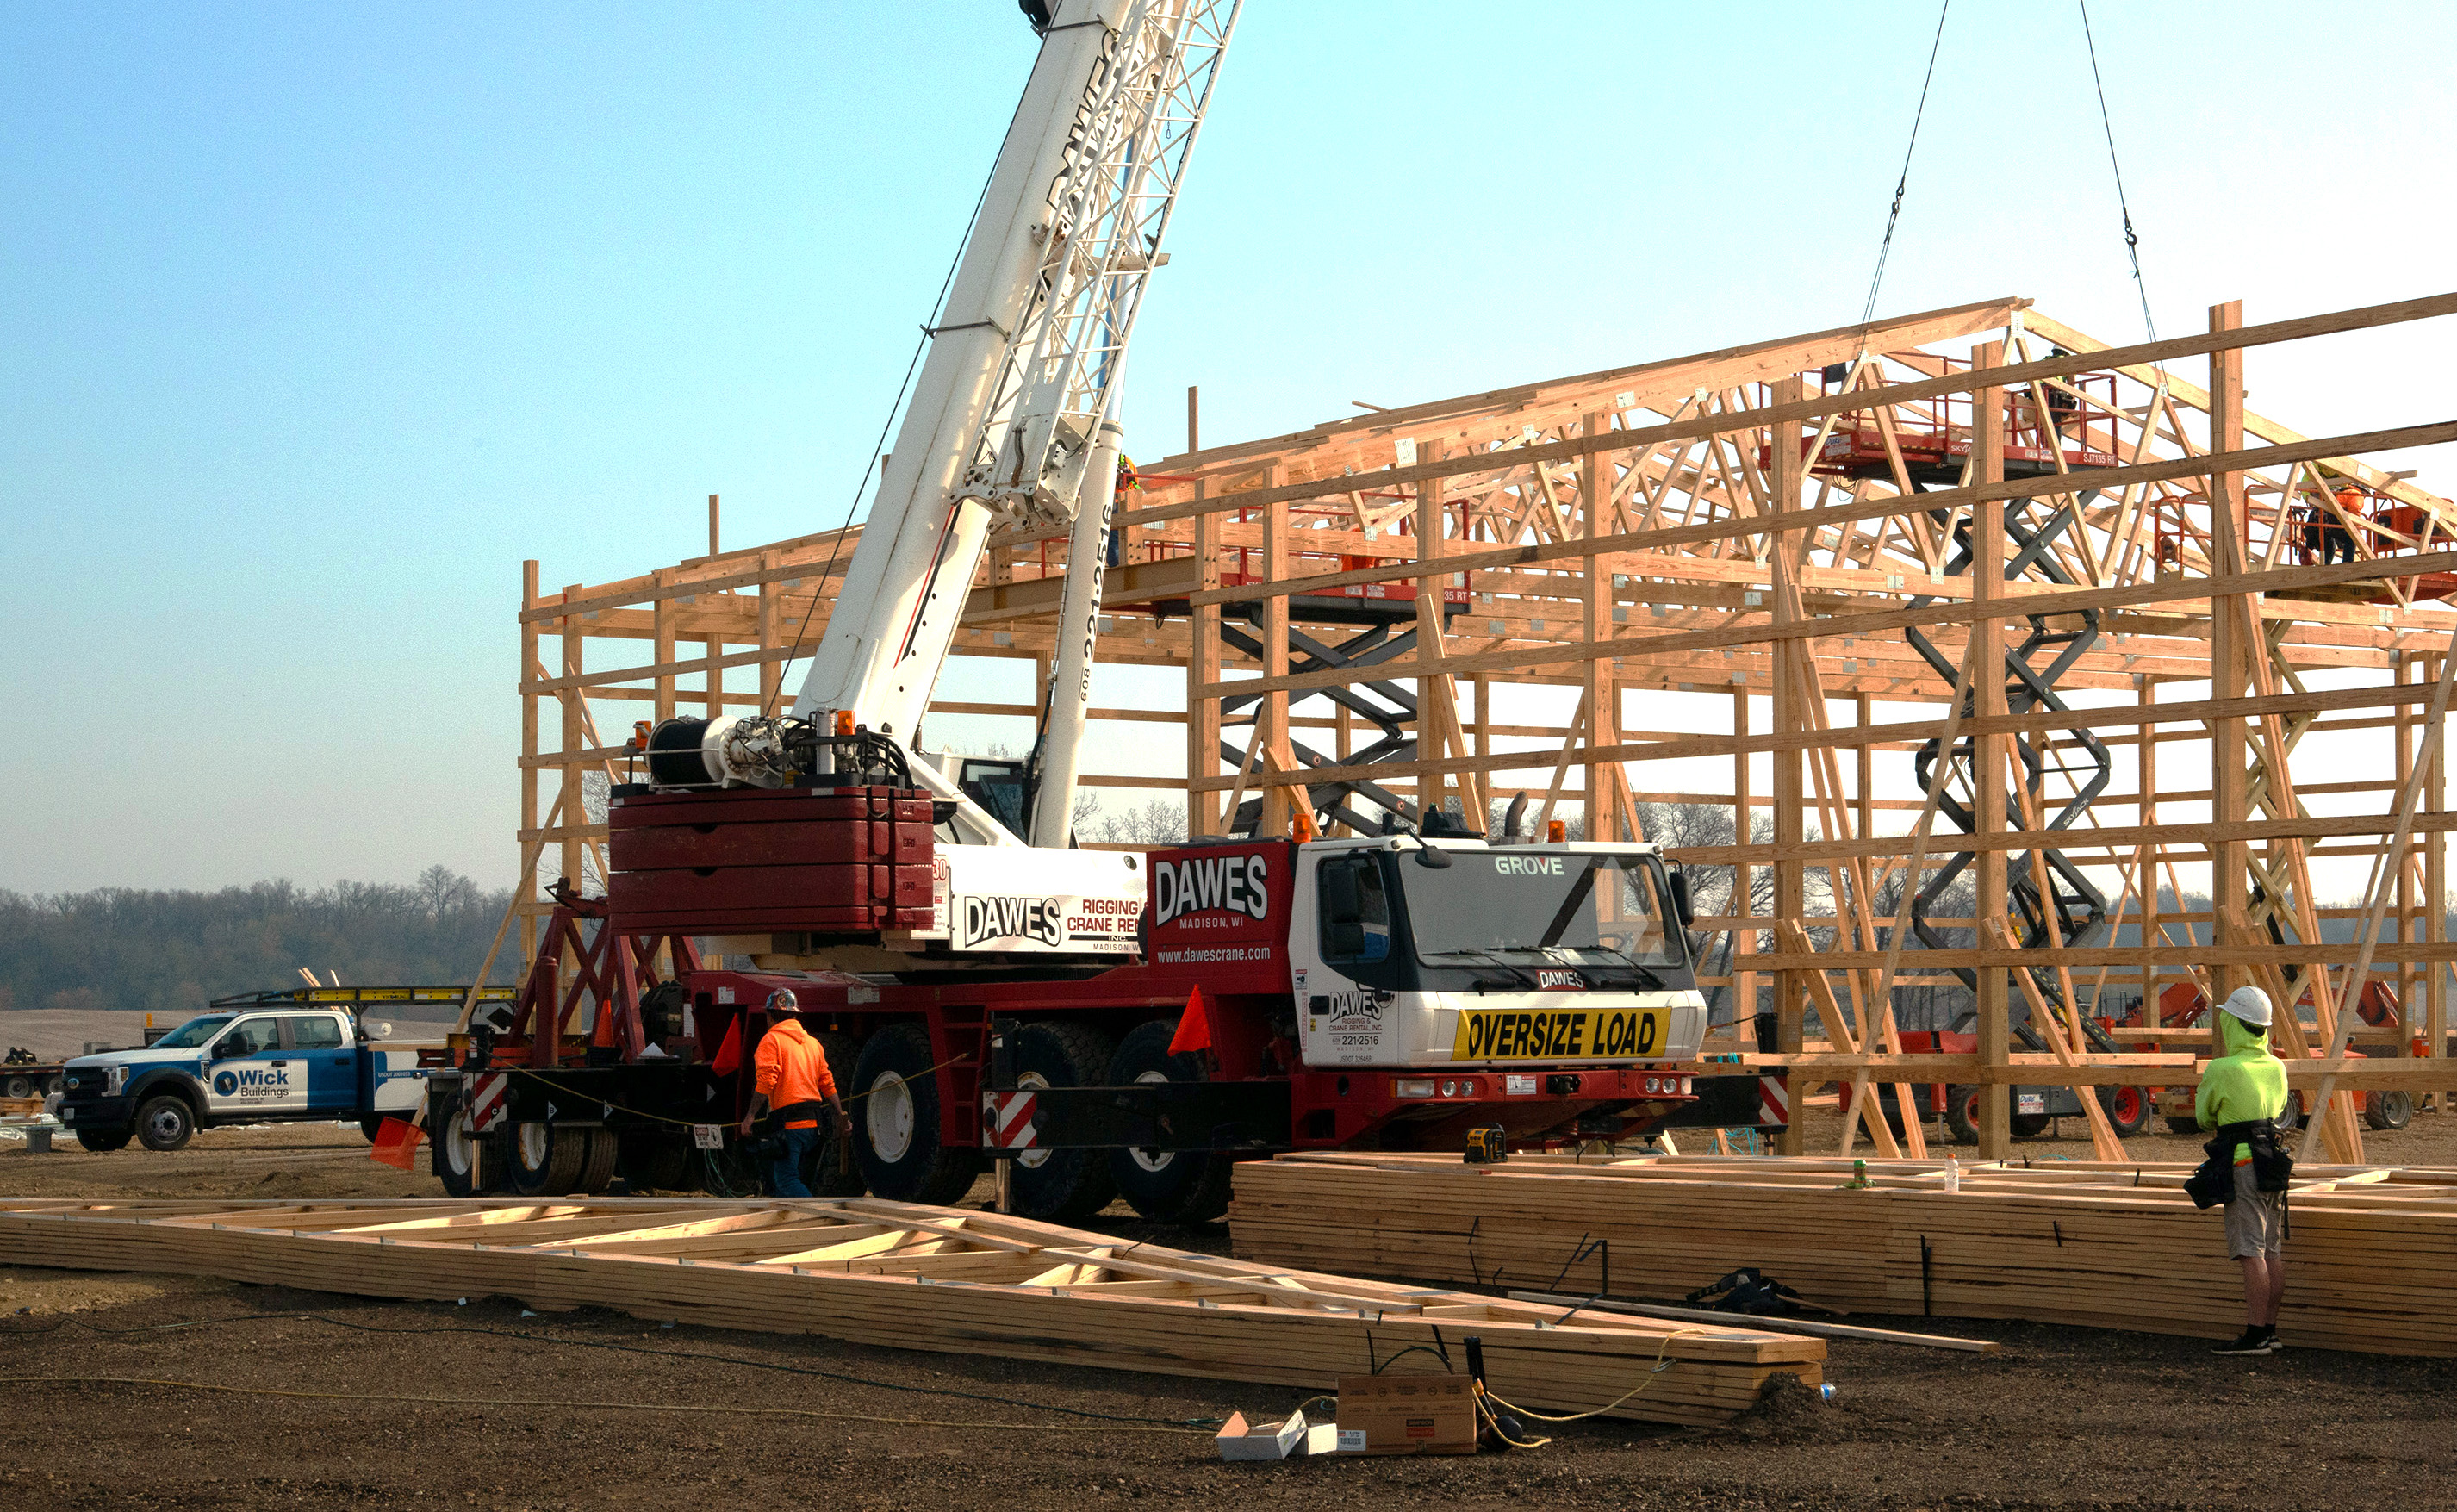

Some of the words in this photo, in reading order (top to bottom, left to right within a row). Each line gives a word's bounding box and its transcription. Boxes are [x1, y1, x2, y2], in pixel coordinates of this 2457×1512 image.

[2083, 453, 2106, 464] SJ7135
[2107, 455, 2116, 464] RT
[1457, 591, 1467, 601] RT
[1079, 668, 1090, 702] 608
[1495, 856, 1565, 875] GROVE
[1155, 853, 1268, 927] DAWES
[1082, 899, 1138, 915] RIGGING
[965, 896, 1061, 948] DAWES
[1067, 917, 1112, 932] CRANE
[1179, 918, 1228, 929] MADISON,
[1231, 916, 1244, 927] WI
[1093, 943, 1131, 952] MADISON,
[1157, 946, 1271, 964] www.dawescrane.com
[1539, 971, 1585, 990] DAWES
[1330, 992, 1382, 1023] DAWES
[1468, 1012, 1587, 1058] OVERSIZE
[1592, 1012, 1656, 1055] LOAD
[239, 1070, 289, 1086] Wick
[241, 1086, 289, 1098] Buildings
